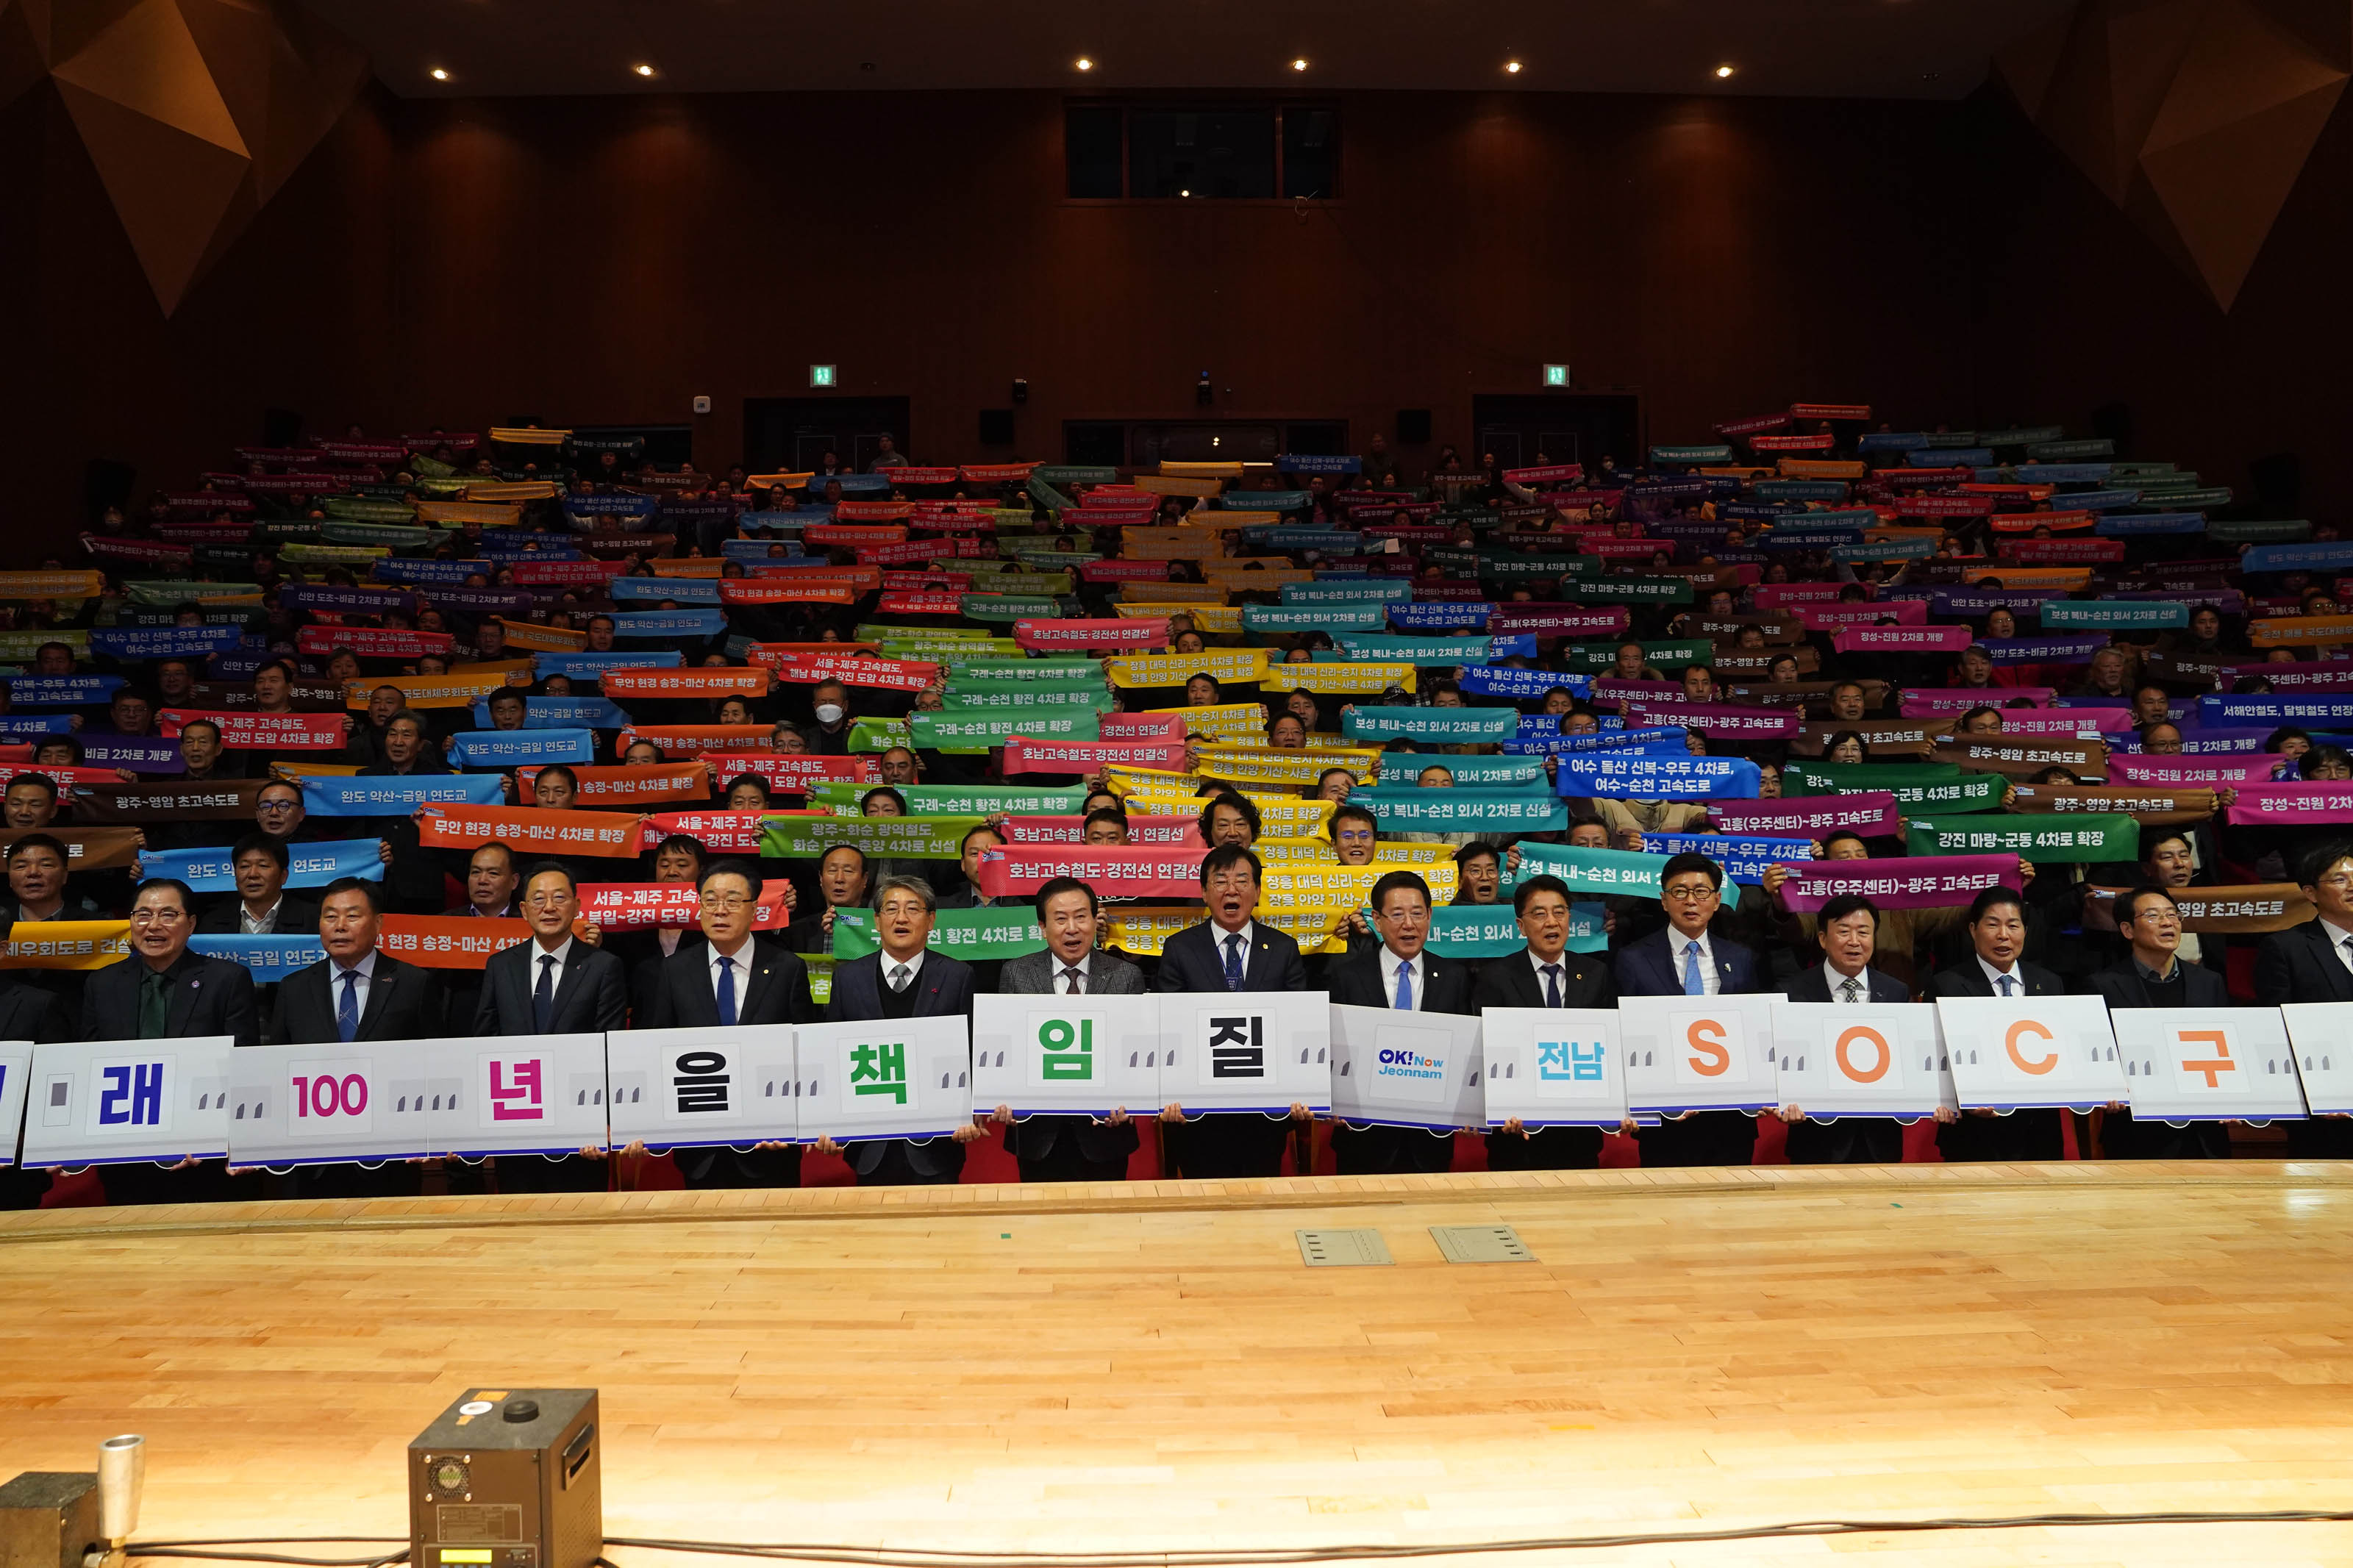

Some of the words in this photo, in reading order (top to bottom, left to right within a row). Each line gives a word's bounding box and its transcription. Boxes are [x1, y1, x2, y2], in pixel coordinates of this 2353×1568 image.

[1122, 629, 1150, 639] 연결선
[1860, 631, 1899, 642] 장성~진원
[1902, 631, 1924, 642] 2차로
[1927, 631, 1943, 642] 개량
[815, 658, 859, 670] 서울~제주
[863, 660, 902, 673] 고속철도,
[615, 677, 635, 688] 무안
[638, 677, 658, 688] 현경
[662, 678, 705, 689] 송정~마산
[708, 677, 733, 688] 4차로
[737, 677, 757, 688] 확장
[790, 668, 810, 679] 해남
[812, 669, 854, 682] 북일~강진
[857, 672, 876, 684] 도암
[878, 673, 904, 685] 4차로
[907, 676, 926, 688] 확장
[2224, 705, 2281, 717] 서해안철도,
[2284, 706, 2329, 717] 달빛철도
[261, 717, 307, 731] 고속철도,
[990, 723, 1013, 734] 황전
[1015, 721, 1046, 733] 4차로
[1050, 720, 1072, 732] 확장
[254, 732, 276, 744] 도암
[279, 733, 310, 744] 4차로
[313, 733, 335, 744] 확장
[113, 748, 144, 762] 2차로
[149, 748, 173, 762] 개량
[468, 743, 490, 756] 완도
[492, 742, 543, 755] 약산~금일
[545, 740, 576, 753] 연도교
[1969, 746, 2024, 762] 광주~영암
[2027, 749, 2085, 764] 초고속도로
[1571, 760, 1597, 773] 여수
[1602, 760, 1627, 773] 돌산
[1631, 760, 1693, 775] 신복~우두
[1695, 762, 1735, 776] 4차로,
[2127, 768, 2181, 781] 장성~진원
[2185, 768, 2218, 781] 2차로
[2221, 767, 2246, 780] 개량
[1596, 779, 1655, 793] 여수~순천
[1659, 780, 1711, 793] 고속도로
[115, 795, 175, 809] 광주~영암
[177, 794, 239, 807] 초고속도로
[341, 790, 366, 803] 완도
[370, 790, 427, 802] 약산~금일
[430, 790, 467, 802] 연도교
[976, 798, 1001, 811] 황전
[1004, 798, 1038, 811] 4차로
[1043, 797, 1068, 810] 확장
[2054, 798, 2111, 811] 광주~영암
[2113, 799, 2174, 811] 초고속도로
[2260, 797, 2324, 812] 장성~진원
[1261, 807, 1294, 820] 4차로
[1297, 806, 1322, 820] 확장
[1364, 804, 1390, 817] 보성
[1393, 803, 1454, 817] 복내~순천
[1457, 803, 1484, 817] 외서
[1488, 803, 1522, 817] 2차로
[1526, 803, 1551, 817] 신설
[1719, 813, 1833, 831] 고흥(우주센터)~광주
[1837, 809, 1883, 826] 고속도로
[435, 820, 461, 834] 무안
[465, 821, 491, 836] 현경
[495, 823, 556, 840] 송정~마산
[559, 826, 595, 841] 4차로
[599, 828, 625, 843] 확장
[812, 823, 874, 836] 광주~화순
[878, 823, 935, 836] 광역철도,
[793, 840, 820, 851] 화순
[889, 840, 926, 852] 4차로
[929, 840, 955, 853] 신설
[1939, 833, 1965, 848] 강진
[1970, 833, 2032, 848] 마량~군동
[2036, 833, 2073, 847] 4차로
[2077, 831, 2104, 846] 확장
[1667, 840, 1699, 854] 돌산
[1701, 842, 1767, 857] 신복~우두
[188, 864, 217, 878] 완도
[293, 858, 336, 873] 연도교
[1158, 864, 1201, 879] 연결선
[1548, 863, 1616, 881] 복내~순천
[1621, 870, 1651, 884] 외서
[1266, 876, 1293, 889] 장흥
[1297, 876, 1322, 888] 대덕
[1797, 878, 1938, 896] 고흥(우주센터)~광주
[1941, 874, 1999, 892] 고속도로
[593, 890, 663, 906] 서울~제주
[2210, 901, 2284, 917] 초고속도로
[946, 927, 976, 944] 황전
[982, 926, 1022, 943] 4차로
[389, 935, 418, 950] 현경
[422, 936, 490, 952] 송정~마산
[1038, 1019, 1093, 1081] 임
[1210, 1017, 1264, 1078] 질
[1688, 1019, 1730, 1077] S
[1835, 1025, 1890, 1084] O
[2005, 1020, 2058, 1075] C
[1379, 1050, 1413, 1065] OK!
[1415, 1056, 1443, 1067] Now
[1538, 1041, 1604, 1081] 전남
[2178, 1030, 2235, 1088] 구
[850, 1043, 908, 1105] 책
[1379, 1066, 1441, 1079] Jeonnam
[490, 1059, 543, 1120] 년
[674, 1051, 730, 1113] 을
[100, 1063, 163, 1125] 래
[293, 1074, 368, 1117] 100
